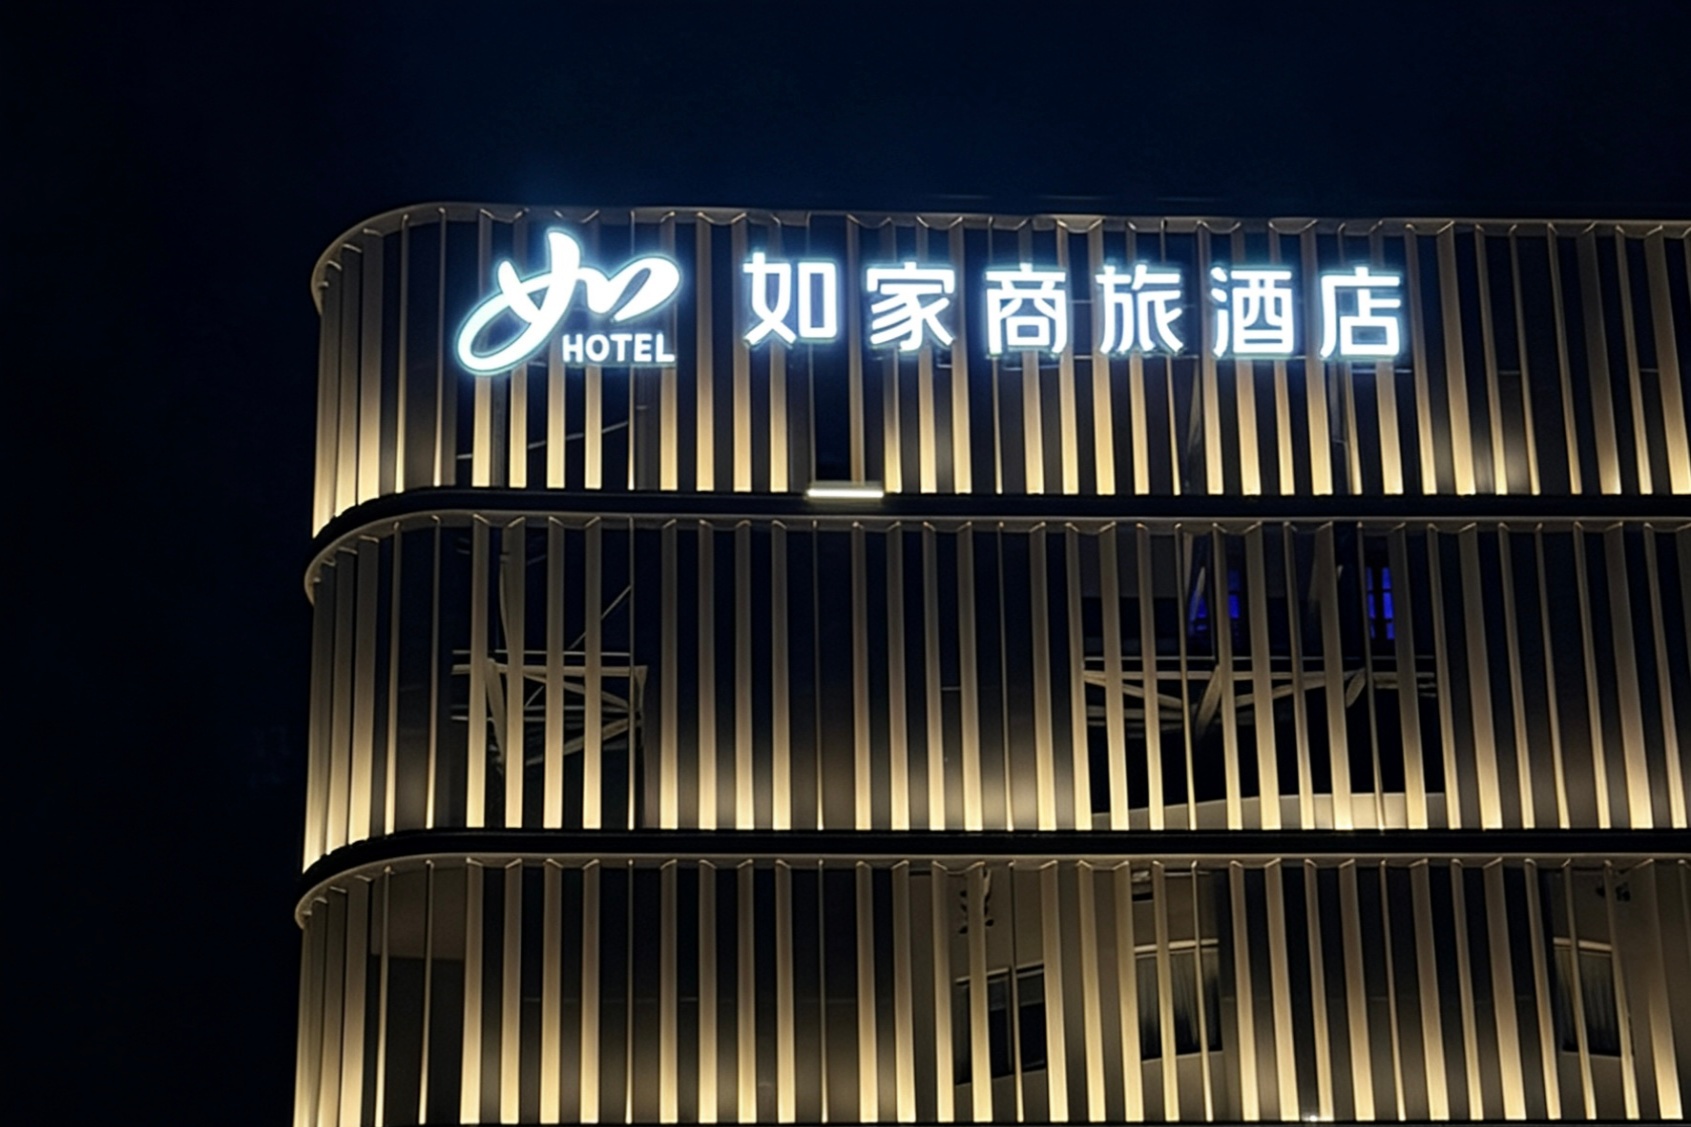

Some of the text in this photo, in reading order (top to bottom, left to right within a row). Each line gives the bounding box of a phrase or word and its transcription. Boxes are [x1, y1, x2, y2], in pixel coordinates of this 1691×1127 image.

[742, 251, 1402, 360] 如家商旅酒店
[562, 332, 676, 364] HOTEL
